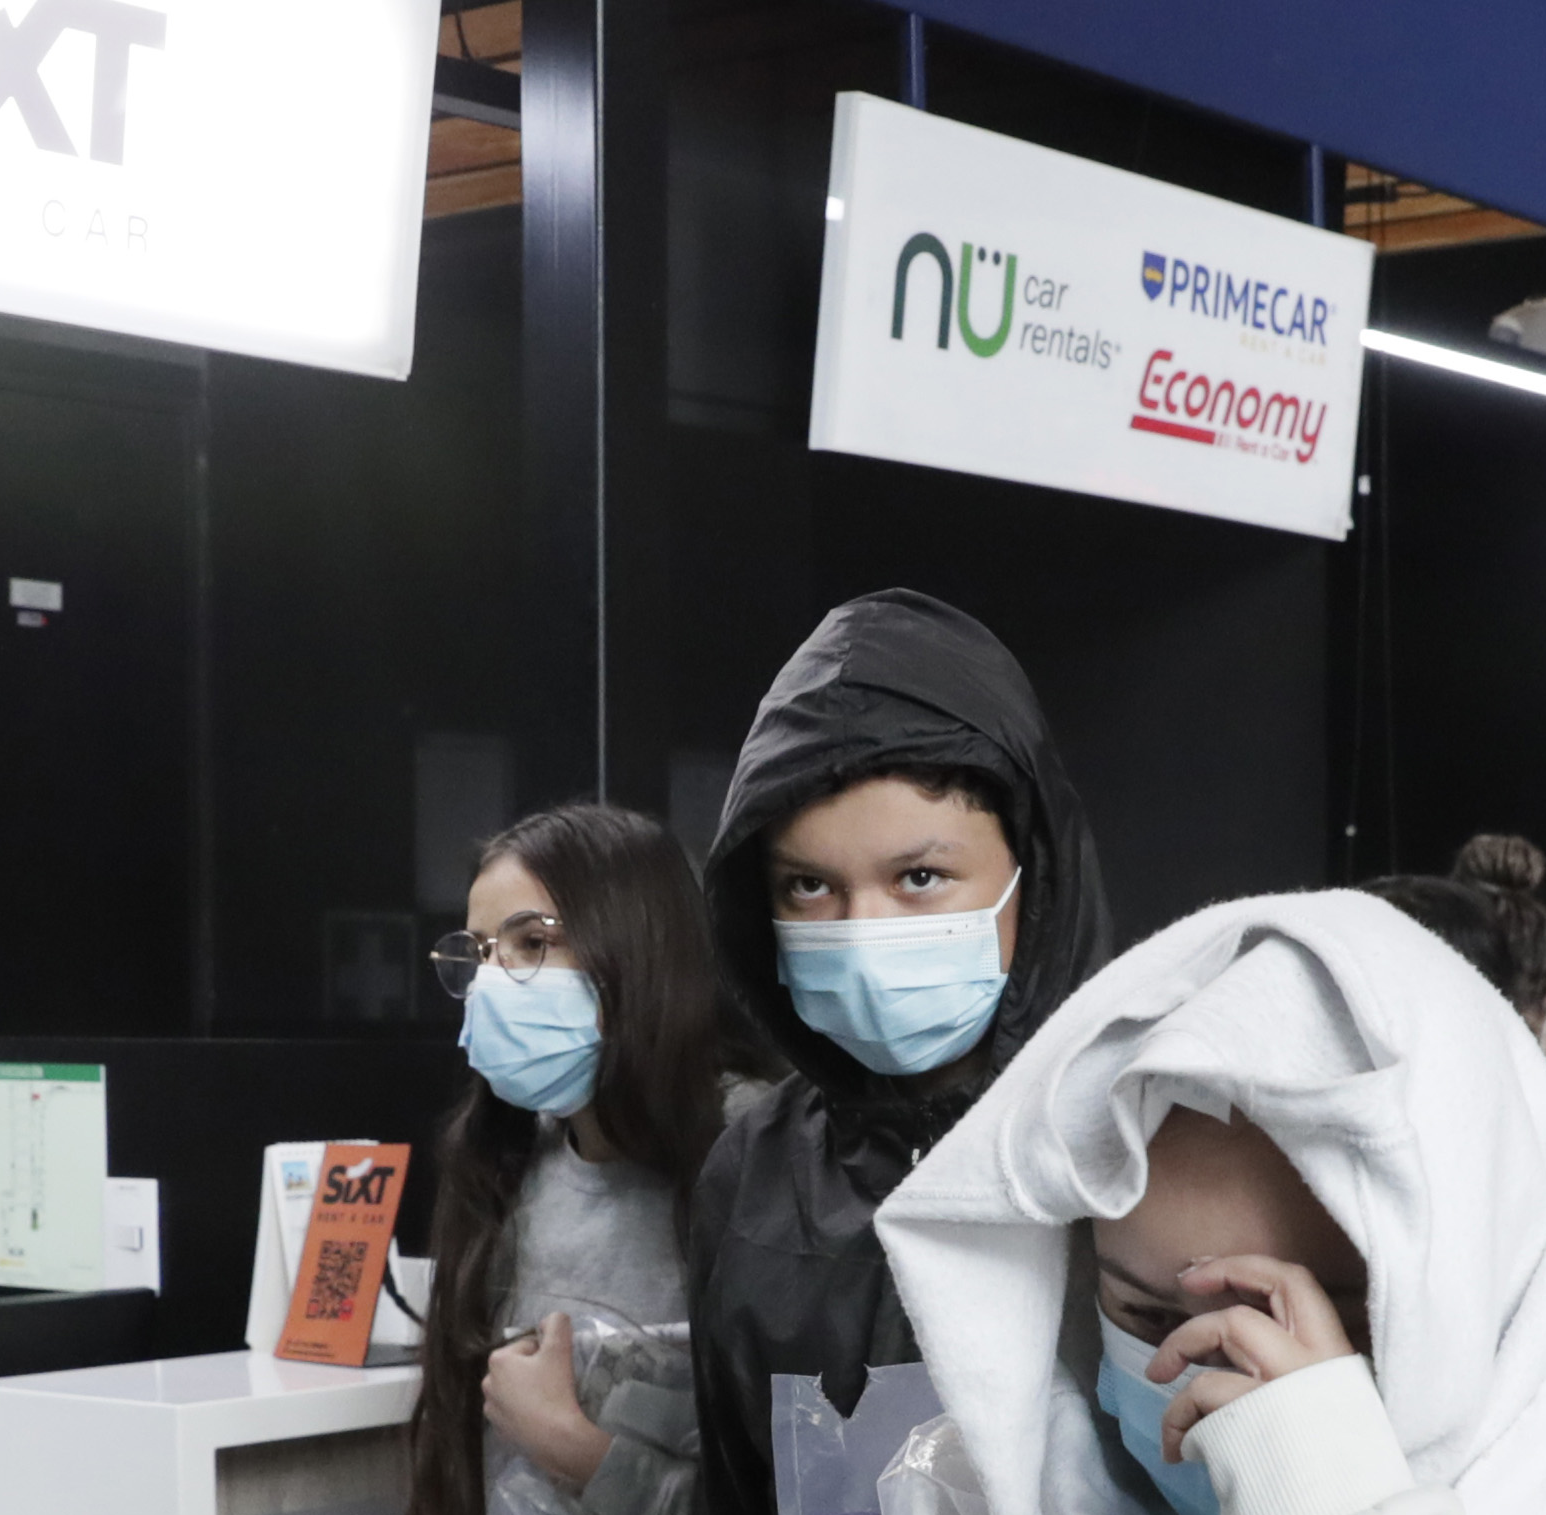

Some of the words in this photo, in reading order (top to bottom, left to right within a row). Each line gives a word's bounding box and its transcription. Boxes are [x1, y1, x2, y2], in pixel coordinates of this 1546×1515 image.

[43, 198, 151, 254] CAR
[1022, 273, 1069, 310] car
[1169, 258, 1327, 346] PRIMECAR
[1139, 349, 1327, 463] Economy
